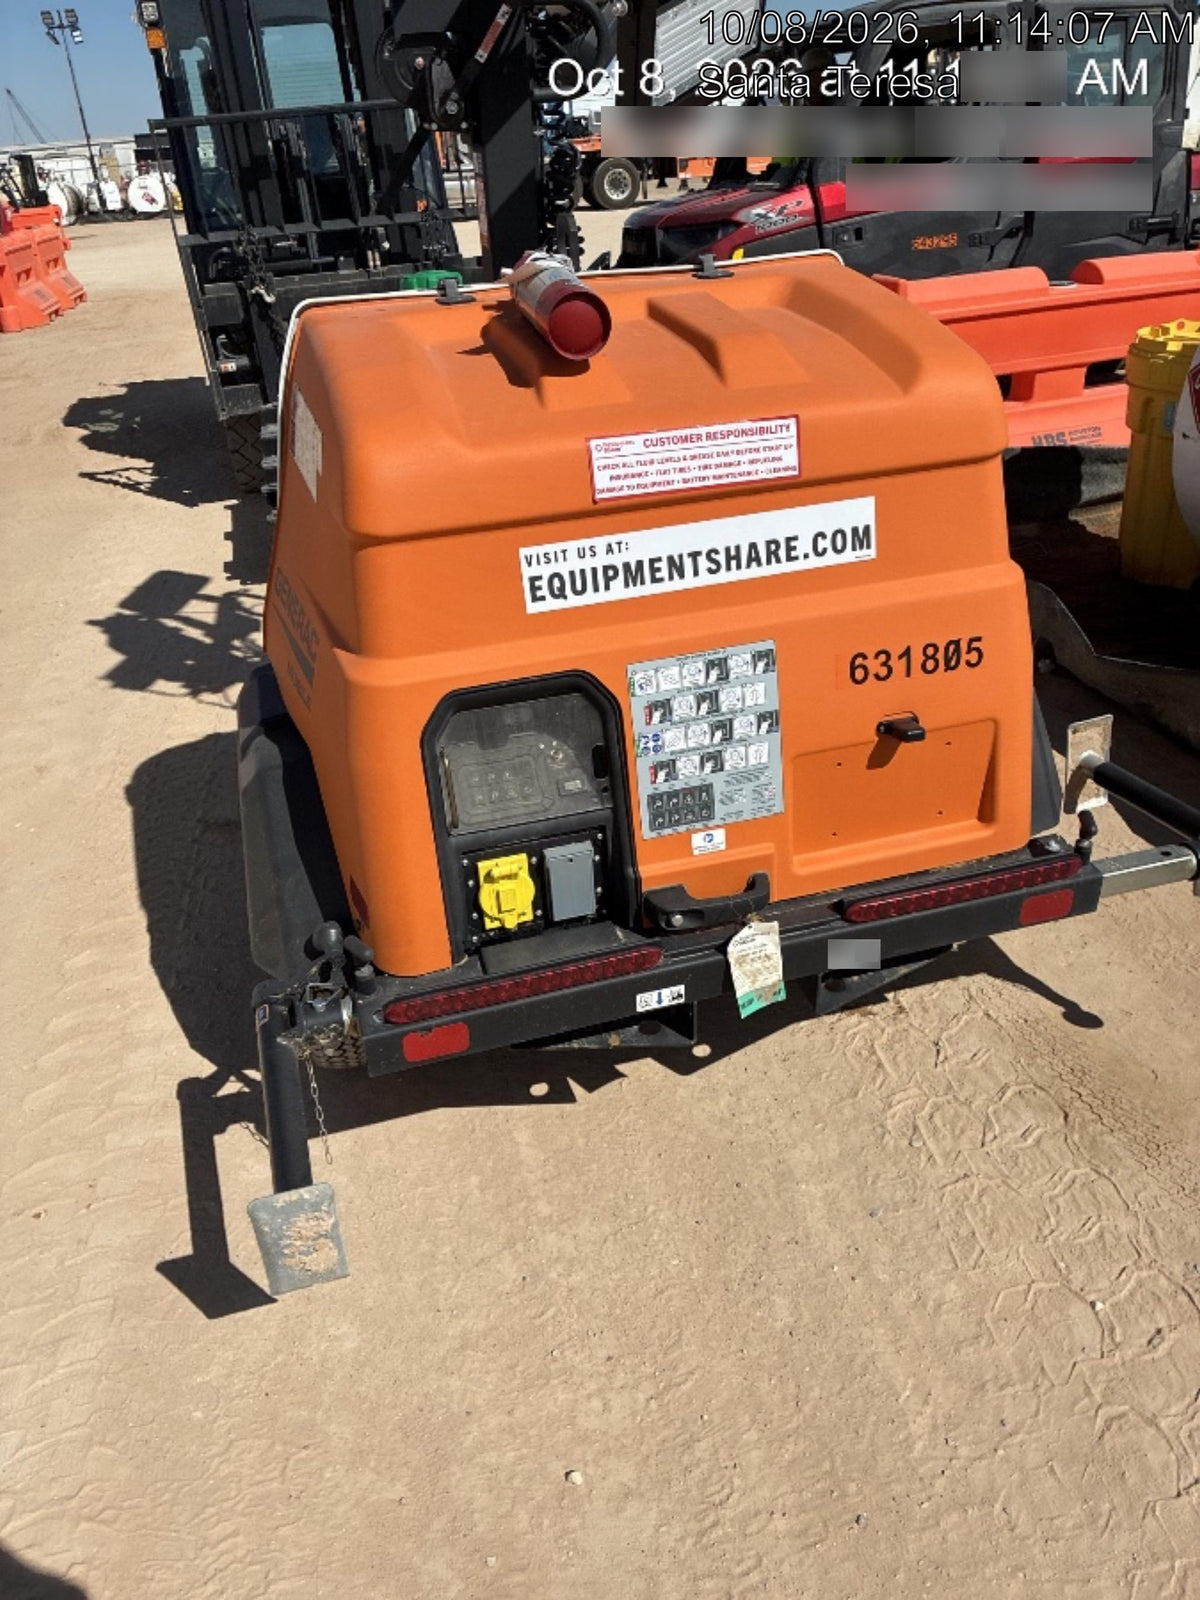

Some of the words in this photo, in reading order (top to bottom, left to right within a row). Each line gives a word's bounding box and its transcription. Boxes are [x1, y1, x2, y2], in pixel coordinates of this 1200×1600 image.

[643, 433, 703, 448] CUSTOMER
[705, 424, 790, 441] RESPONSIBILITY
[524, 549, 569, 568] VISIT
[577, 545, 597, 560] US
[605, 541, 630, 556] AT:
[527, 523, 873, 604] EQUIPMENTSHARE.COM
